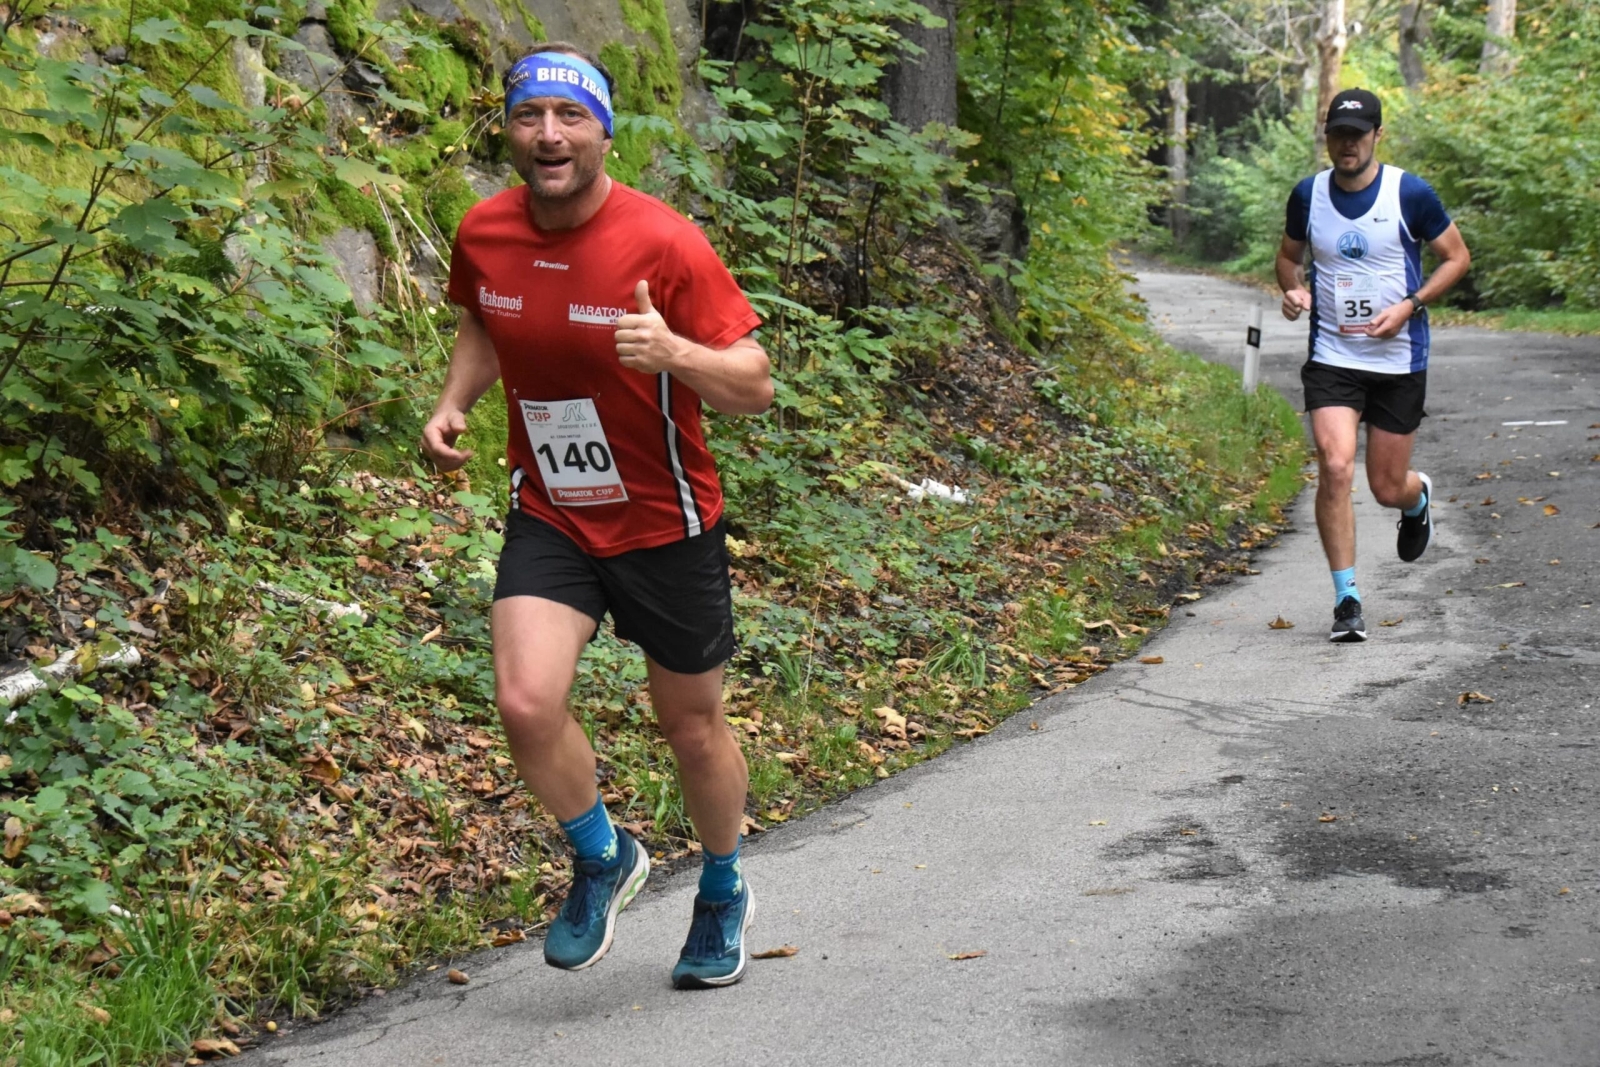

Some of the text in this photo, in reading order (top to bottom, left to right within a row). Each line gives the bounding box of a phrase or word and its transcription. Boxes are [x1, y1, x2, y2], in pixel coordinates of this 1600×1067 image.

[537, 67, 579, 85] BIEG
[569, 303, 627, 318] MARATON
[1344, 299, 1373, 318] 35
[526, 411, 551, 422] CUP
[537, 441, 611, 474] 140
[557, 488, 614, 498] PRIMATOR CUP
